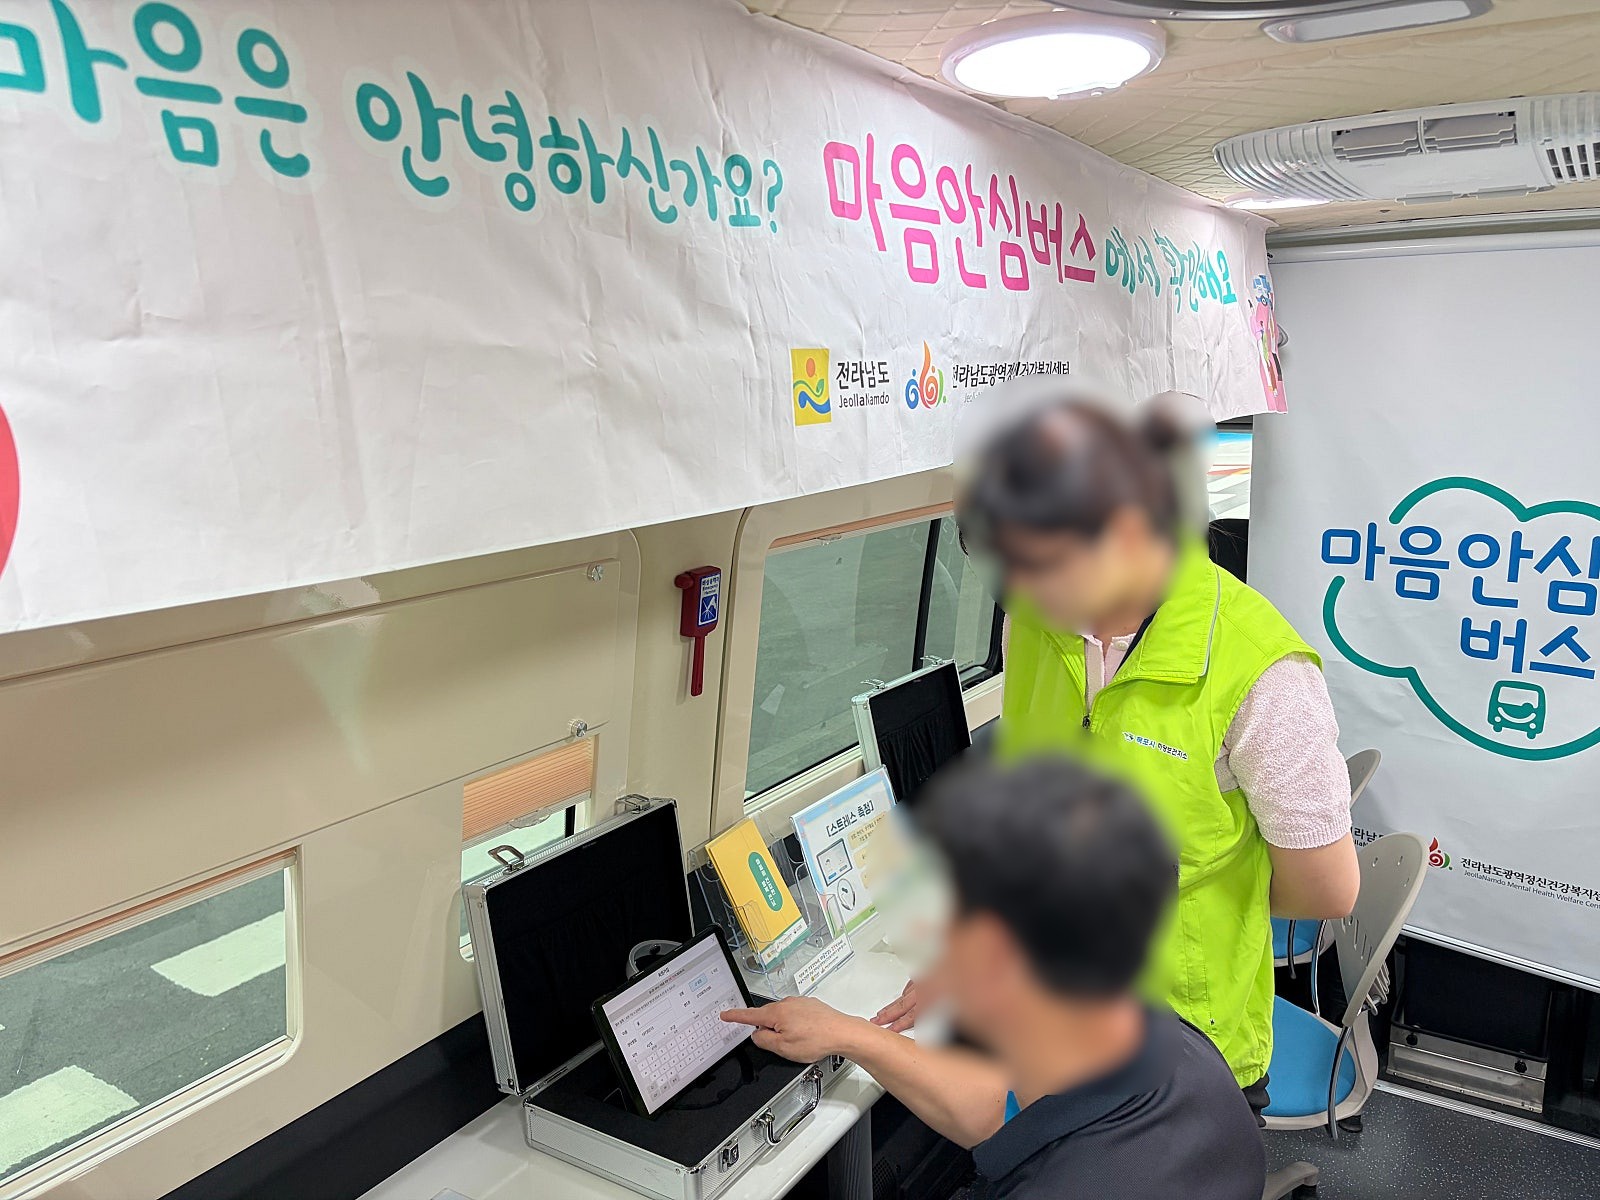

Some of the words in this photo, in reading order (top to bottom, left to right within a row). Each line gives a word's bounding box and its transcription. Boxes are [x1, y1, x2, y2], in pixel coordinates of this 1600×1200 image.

[0, 0, 310, 178] 마음은
[355, 71, 783, 234] 안녕하신가요?
[836, 360, 890, 390] 전라남도
[838, 392, 890, 409] JeollaNamdo
[1320, 522, 1600, 616] 마음안심
[1460, 616, 1596, 680] 버스
[1350, 825, 1384, 843] 라남
[1464, 870, 1506, 886] JeollaNamdo
[1507, 881, 1531, 893] Mental
[1532, 887, 1556, 899] Health
[1556, 893, 1584, 906] Welfare
